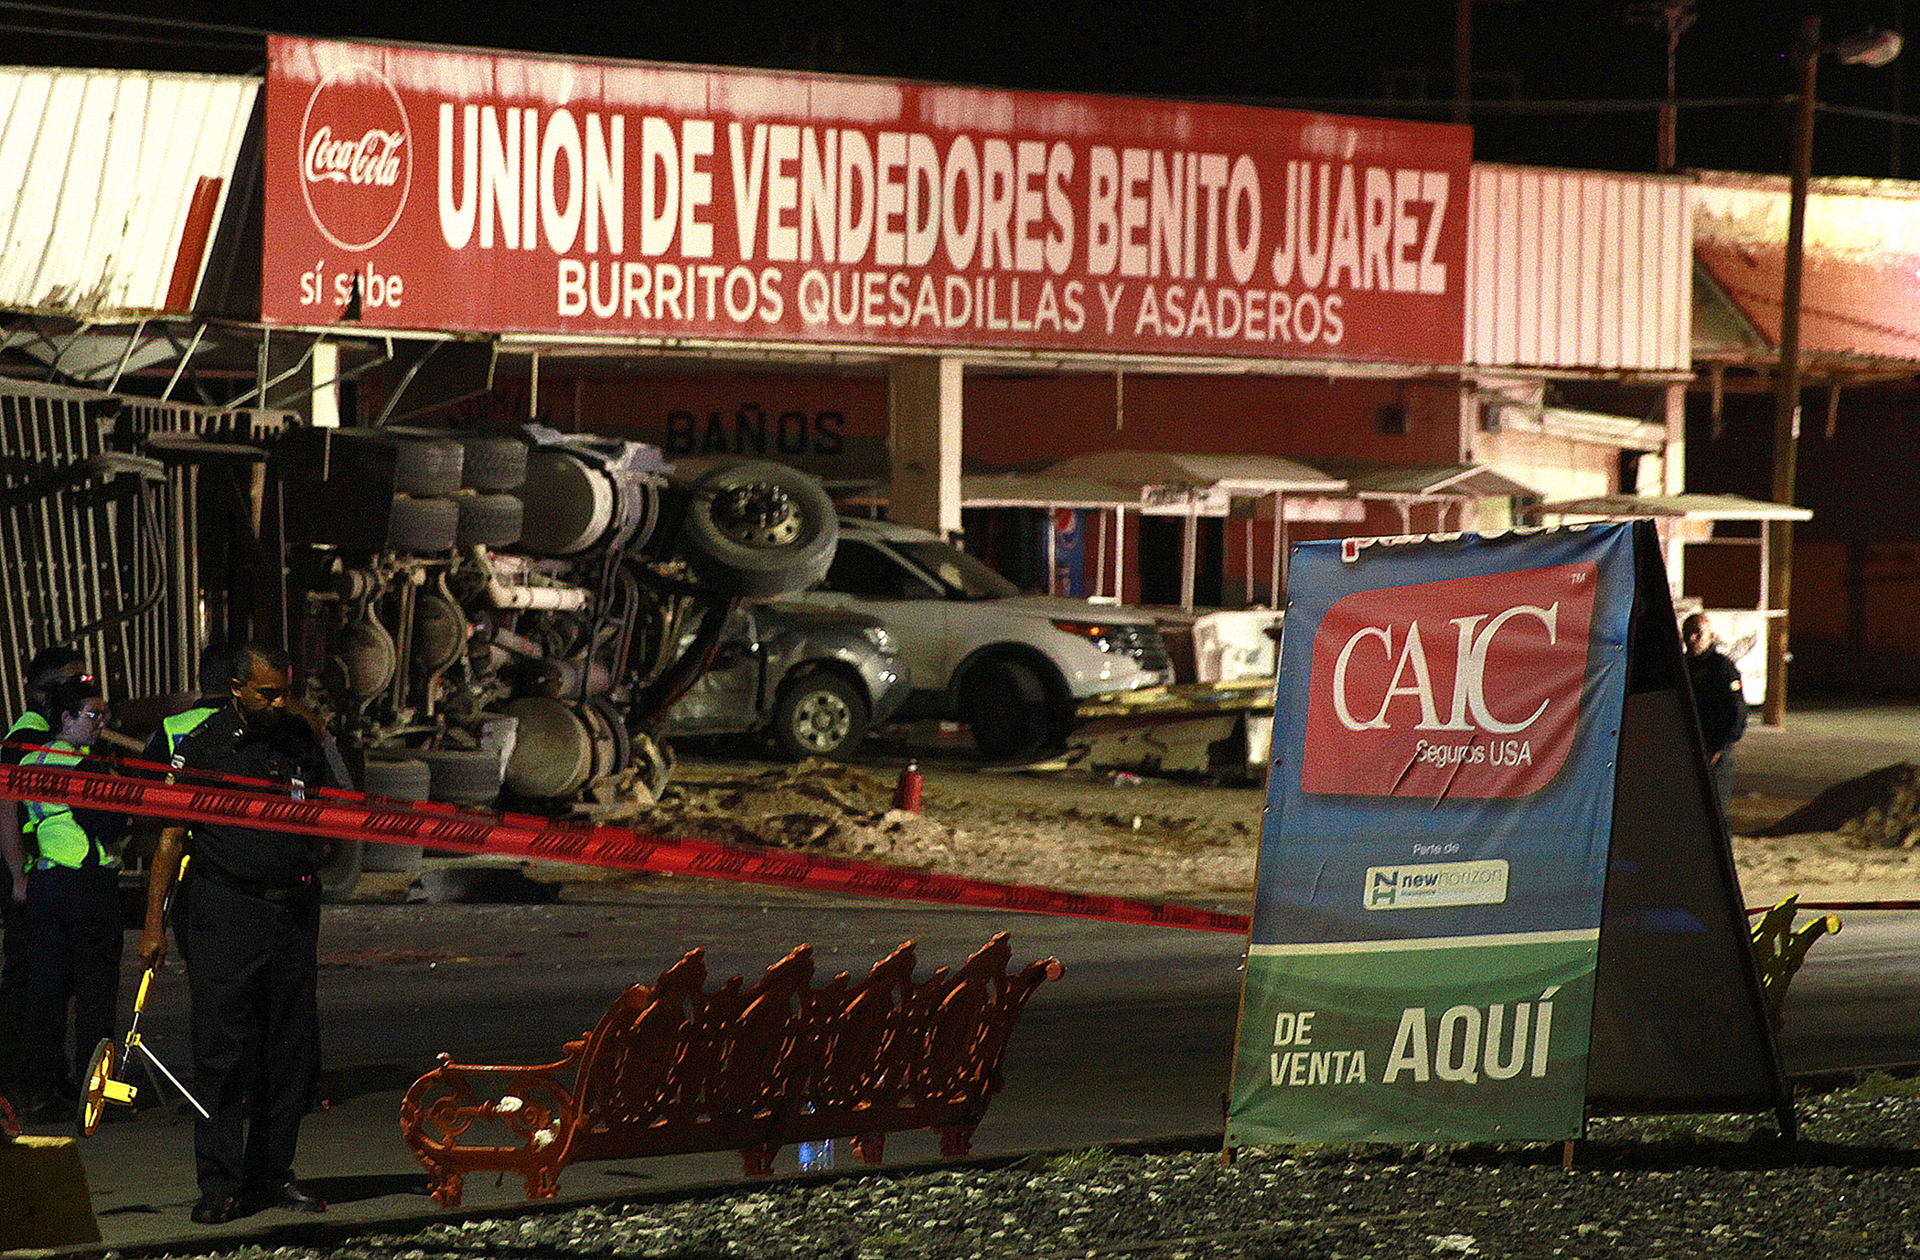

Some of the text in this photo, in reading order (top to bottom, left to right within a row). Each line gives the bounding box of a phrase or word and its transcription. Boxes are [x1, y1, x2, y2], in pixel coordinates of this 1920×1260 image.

[641, 115, 715, 258] DE
[728, 121, 1076, 274] VENDEDORES
[1087, 145, 1262, 284] BENITO
[1271, 128, 1449, 295] JUÁREZ
[300, 260, 324, 306] sí
[558, 259, 1345, 344] BURRITOS QUESADILLAS Y ASADEROS
[665, 402, 846, 457] BAÑOS
[1332, 601, 1560, 735] CAIC
[1416, 739, 1533, 769] Seguros USA
[1412, 842, 1460, 856] Parte de
[1273, 1011, 1316, 1046] DE
[1382, 985, 1562, 1085] AQUÍ
[1270, 1050, 1367, 1086] VENTA
